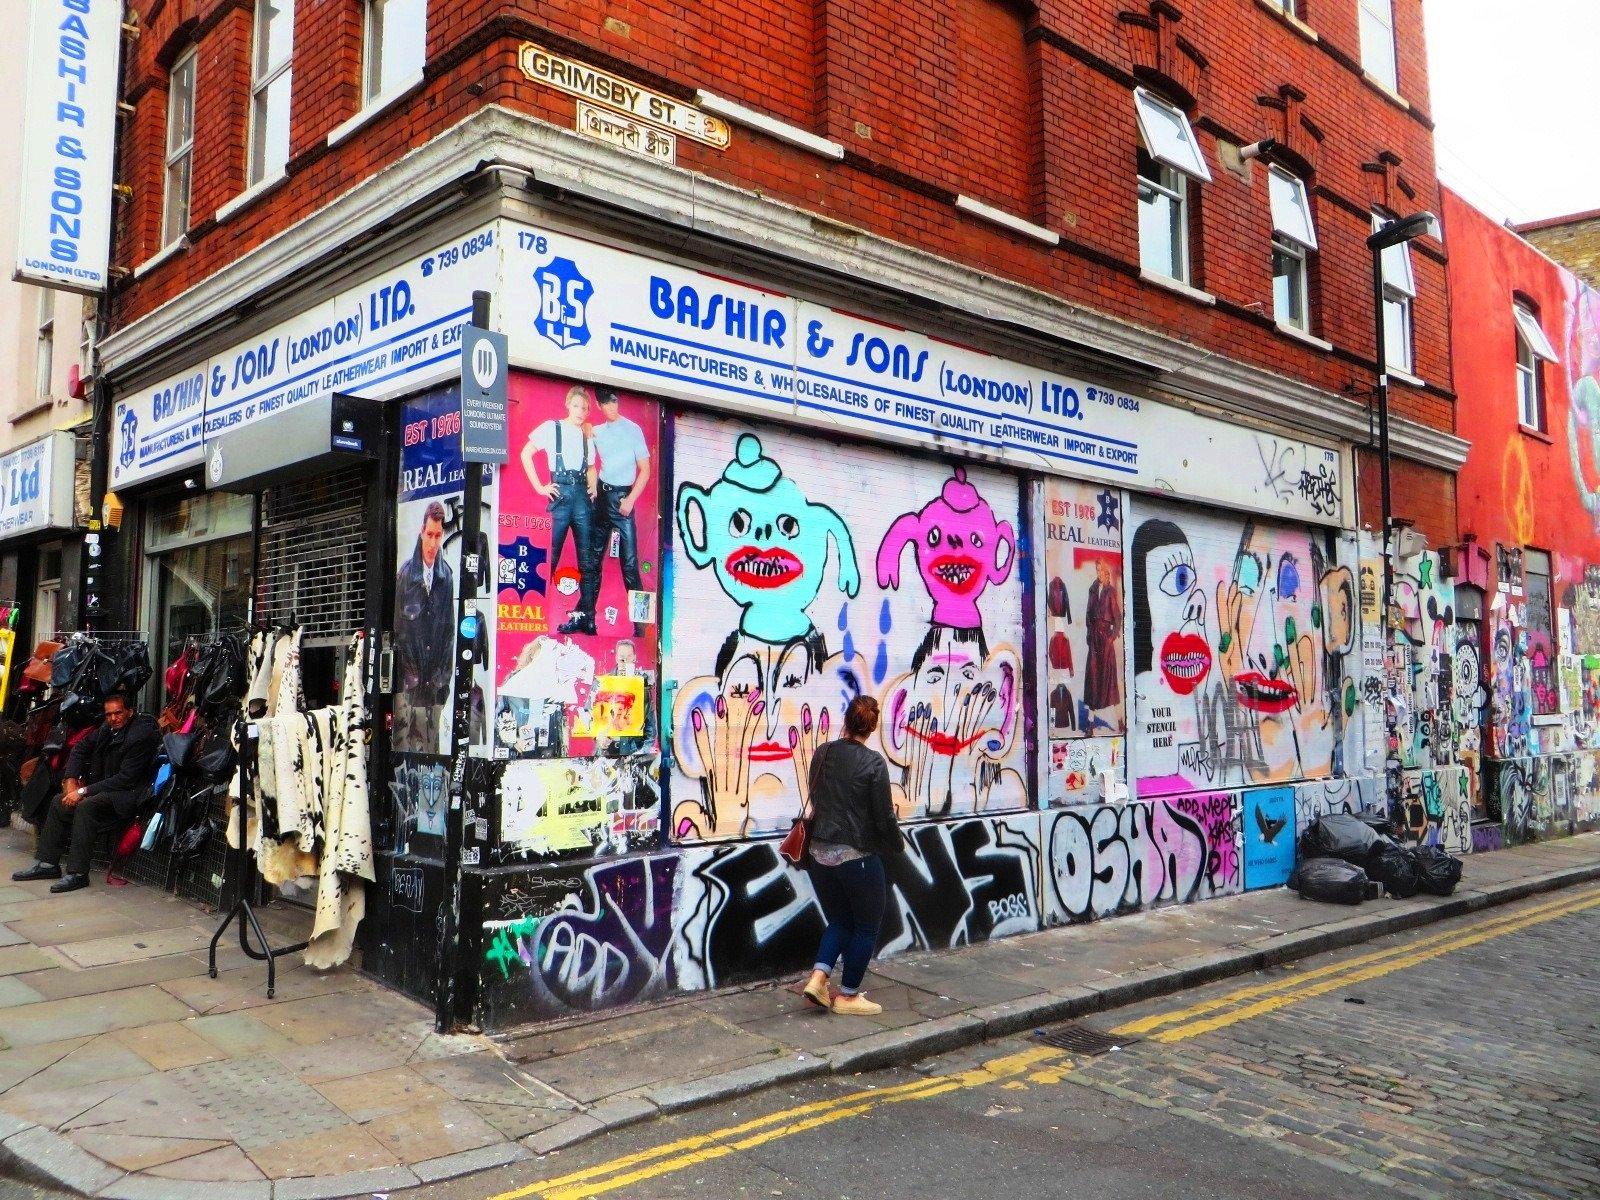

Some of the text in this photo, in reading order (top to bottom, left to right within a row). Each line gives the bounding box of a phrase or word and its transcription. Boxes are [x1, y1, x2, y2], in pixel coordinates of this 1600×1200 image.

[532, 52, 641, 112] GRIMSBY
[649, 97, 677, 126] ST.
[55, 135, 87, 161] &
[49, 166, 82, 263] SONS
[438, 230, 494, 271] 739 0834
[517, 231, 548, 255] 178
[153, 279, 416, 422] BASHIR & SONS (LONDON) LTD.
[649, 275, 1084, 421] BASHIR & SONS (LONDON) LTD.
[140, 432, 185, 458] MANUFACTURERS
[191, 409, 243, 438] WHOLESALERS
[245, 404, 256, 419] OF
[259, 395, 285, 415] FINEST
[286, 379, 320, 404] QUALITY
[321, 353, 387, 390] LEATHERWEAR
[390, 339, 427, 365] IMPORT
[432, 333, 439, 349] &
[466, 398, 504, 411] EVERY WEEKEND
[610, 335, 1138, 465] MANUFACTURERS & WHOLESALERS OF FINEST QUALITY LEATHERWEAR IMPORT & EXPORT
[1097, 390, 1140, 413] 739 0834
[404, 411, 461, 447] EST 1976
[469, 420, 503, 431] SOUNDSYSTEM
[487, 411, 507, 421] ULTIMATE
[1324, 451, 1334, 462] 178
[10, 459, 40, 506] Ltd
[402, 462, 496, 492] REAL LEARS
[498, 515, 520, 528] EST
[1052, 500, 1096, 522] EST 1976
[1047, 523, 1121, 549] REAL LEATHERS
[518, 545, 530, 590] B & S
[498, 604, 546, 620] REAL
[1151, 706, 1172, 719] YOUR
[1146, 721, 1176, 734] STENCIL
[1152, 736, 1173, 748] HERE
